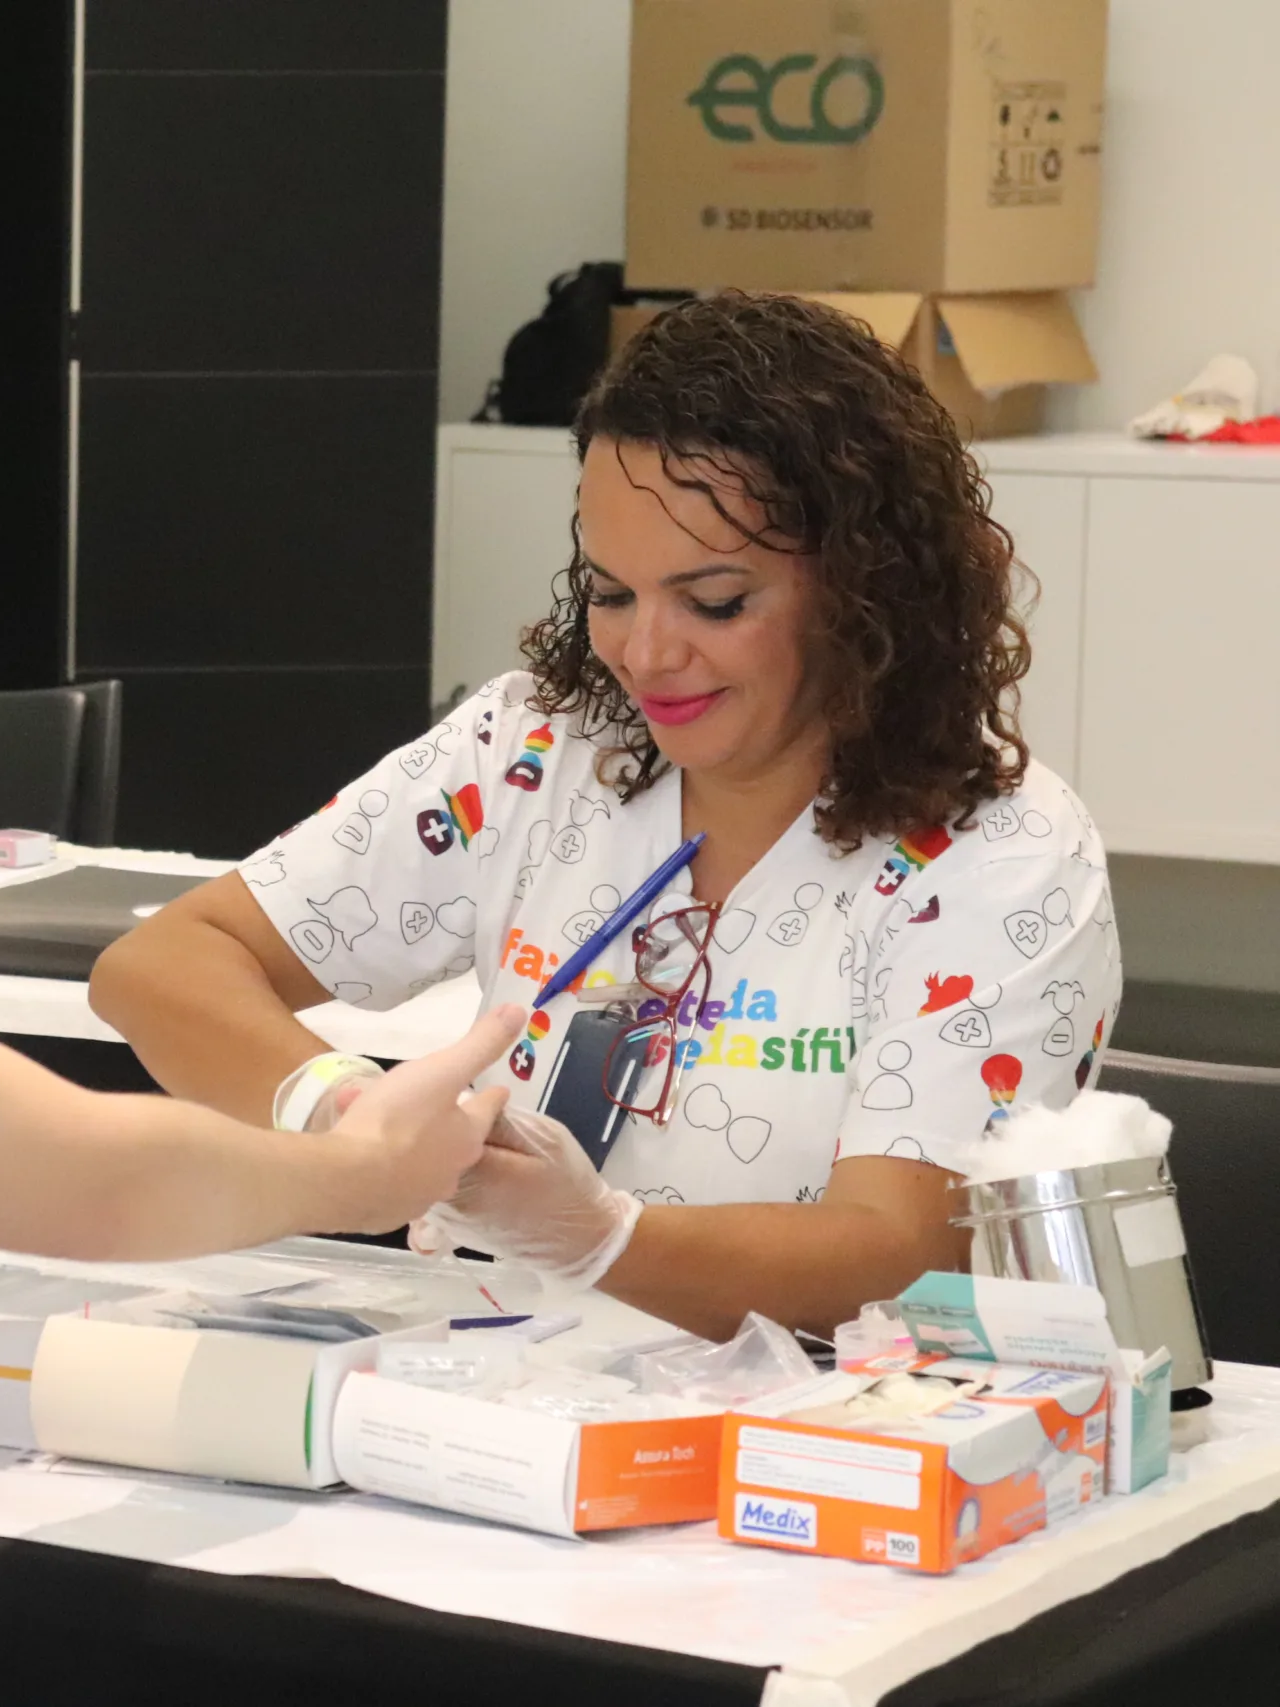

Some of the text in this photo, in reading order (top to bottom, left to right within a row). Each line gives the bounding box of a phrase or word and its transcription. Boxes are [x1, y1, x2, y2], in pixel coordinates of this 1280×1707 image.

[726, 207, 874, 231] SD BIOSENSOR
[760, 1027, 857, 1073] sífil
[742, 1501, 811, 1533] Medix
[889, 1538, 915, 1553] 100
